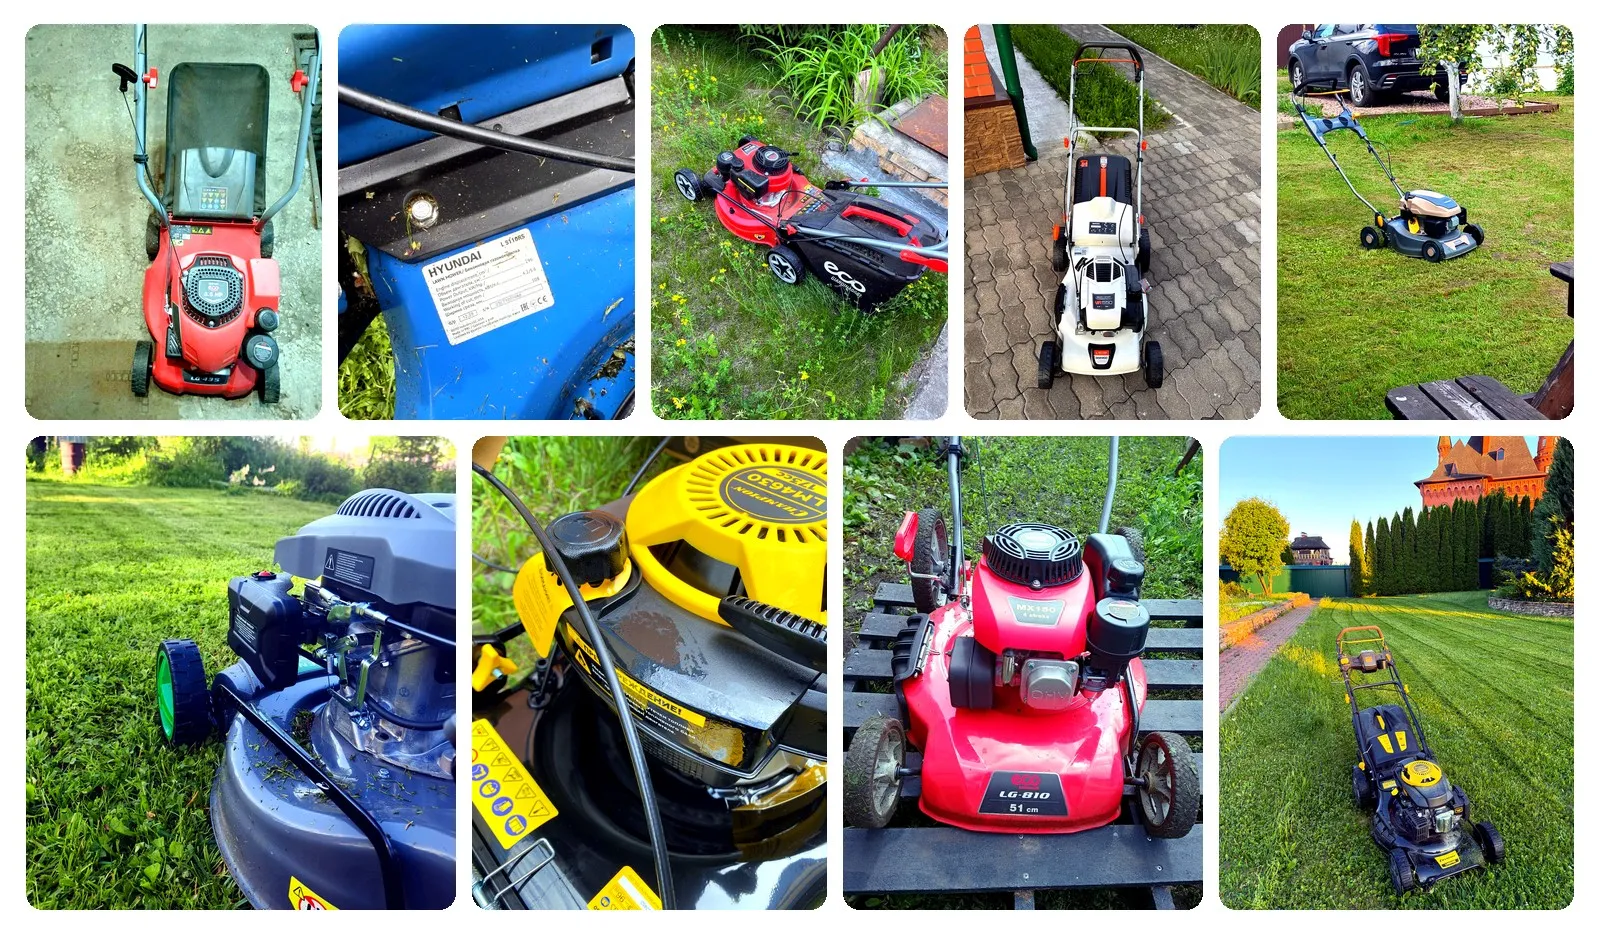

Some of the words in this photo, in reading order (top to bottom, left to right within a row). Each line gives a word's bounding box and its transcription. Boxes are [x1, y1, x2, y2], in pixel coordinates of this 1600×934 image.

[428, 251, 482, 277] HYUNDAI
[823, 260, 867, 293] eco
[733, 486, 809, 517] CHAMPION
[747, 473, 826, 507] LM4630
[999, 790, 1051, 799] LG-810
[1009, 803, 1023, 812] 51
